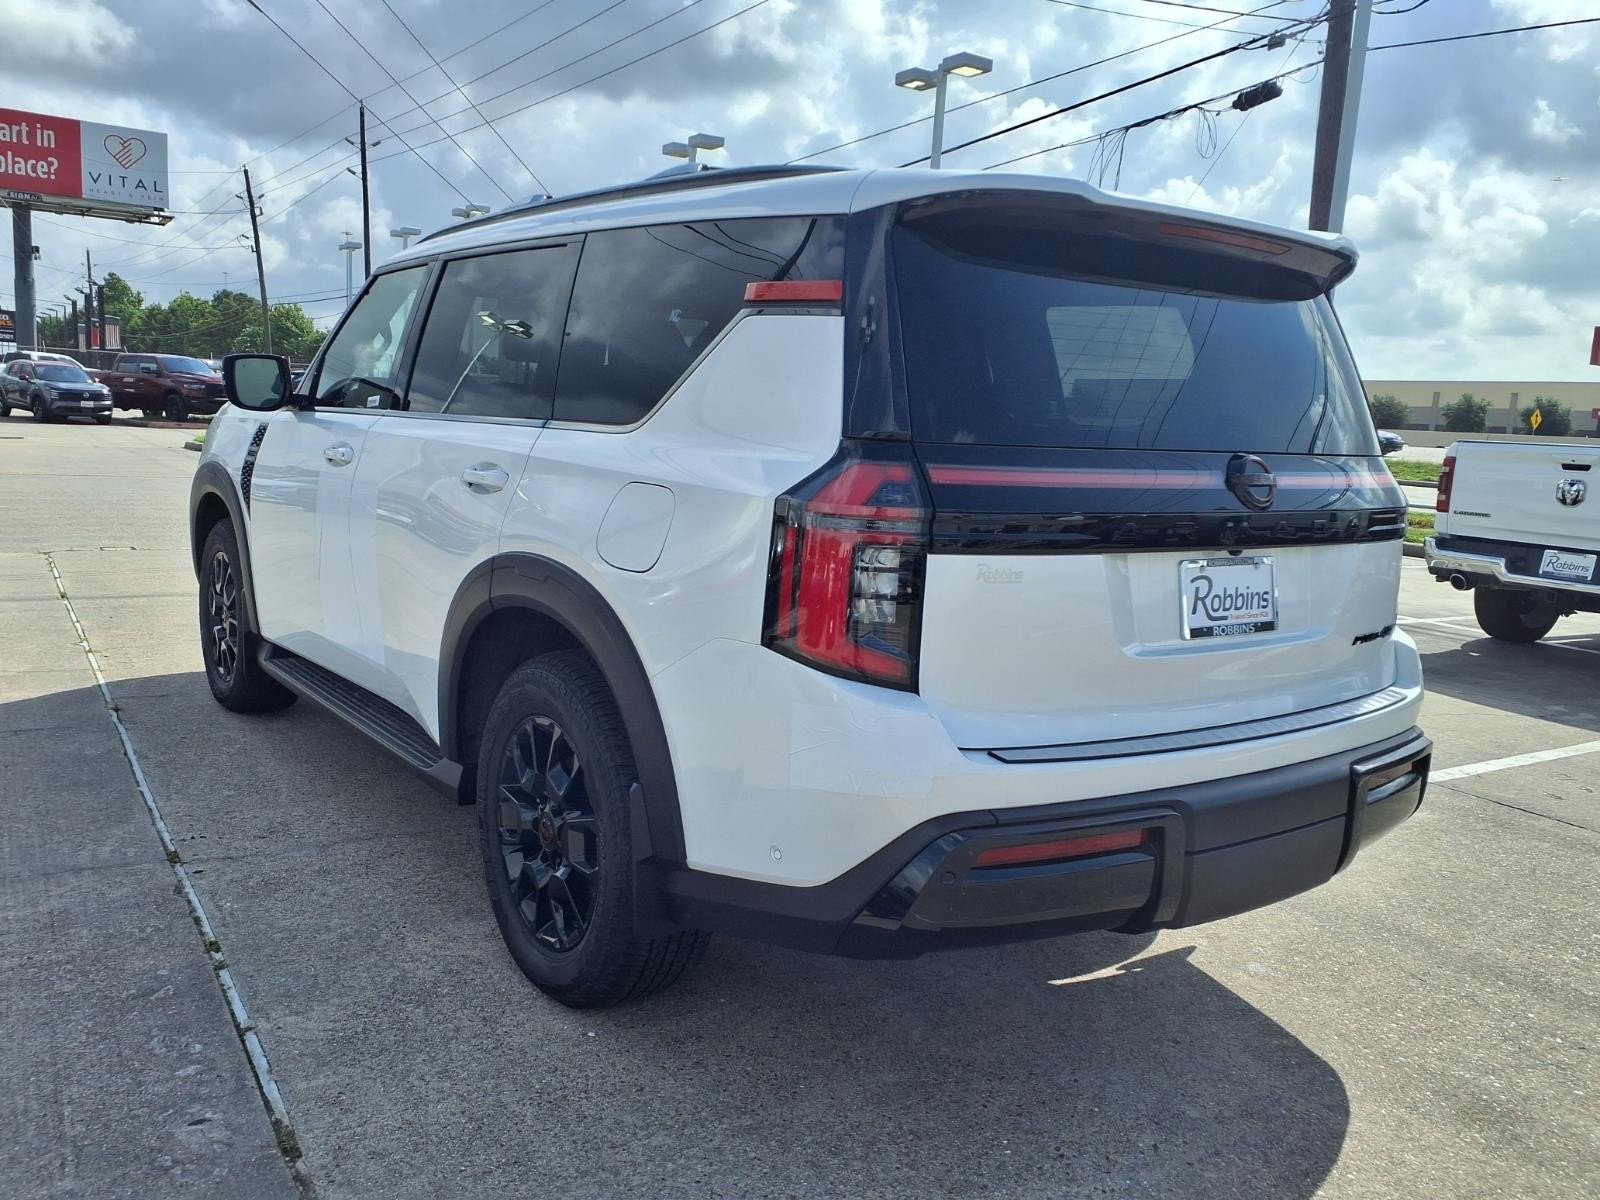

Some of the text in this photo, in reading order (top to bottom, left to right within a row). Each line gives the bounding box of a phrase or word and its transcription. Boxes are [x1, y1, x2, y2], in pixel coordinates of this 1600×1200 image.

[36, 123, 56, 149] in
[88, 171, 164, 194] VITAL
[1546, 555, 1591, 573] Robbins
[1190, 574, 1270, 622] Robbins
[1213, 623, 1256, 637] ROBBINS
